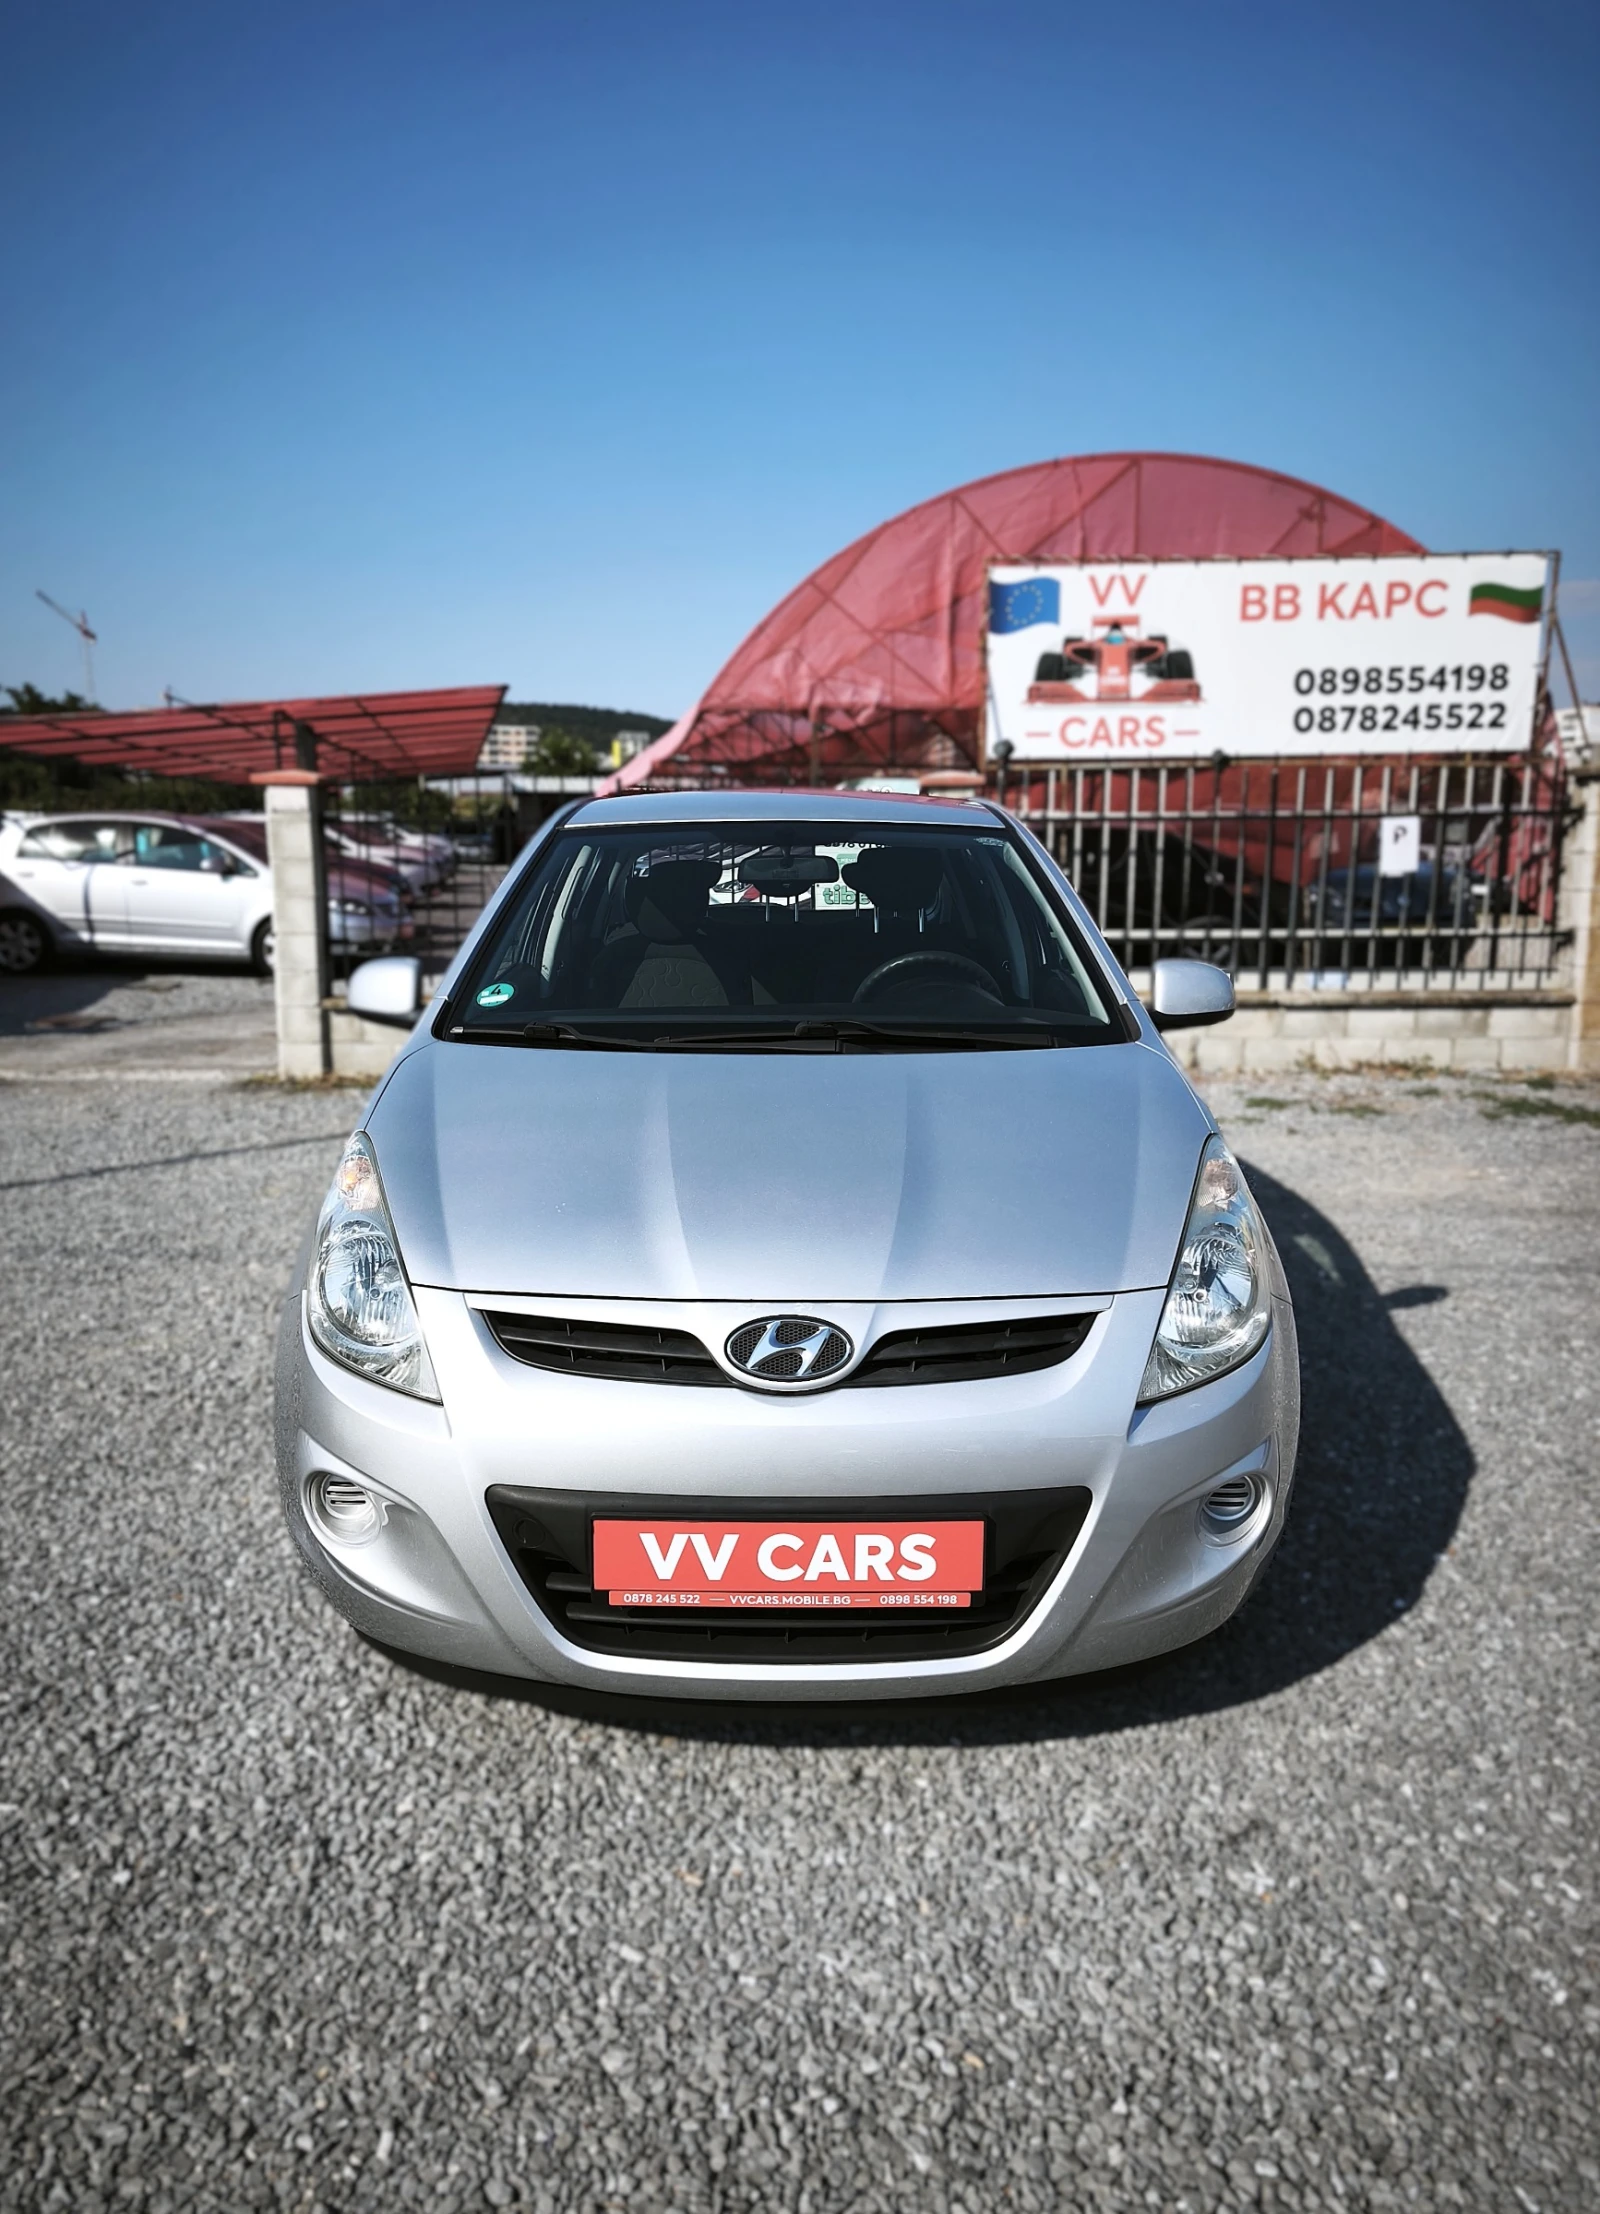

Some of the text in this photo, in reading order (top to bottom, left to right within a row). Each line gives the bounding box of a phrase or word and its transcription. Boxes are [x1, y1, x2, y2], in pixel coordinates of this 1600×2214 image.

[1088, 574, 1147, 607] VV
[1239, 579, 1449, 622] ВВ КАРС
[1293, 663, 1509, 696] 0898554198
[1058, 716, 1166, 748] CARS
[1293, 702, 1506, 733] 0878245522
[490, 984, 502, 995] 4
[638, 1532, 937, 1582] VV CARS
[623, 1593, 957, 1606] 0878 245 522 VVCARS.MOBILE.BG 0898 554 198
